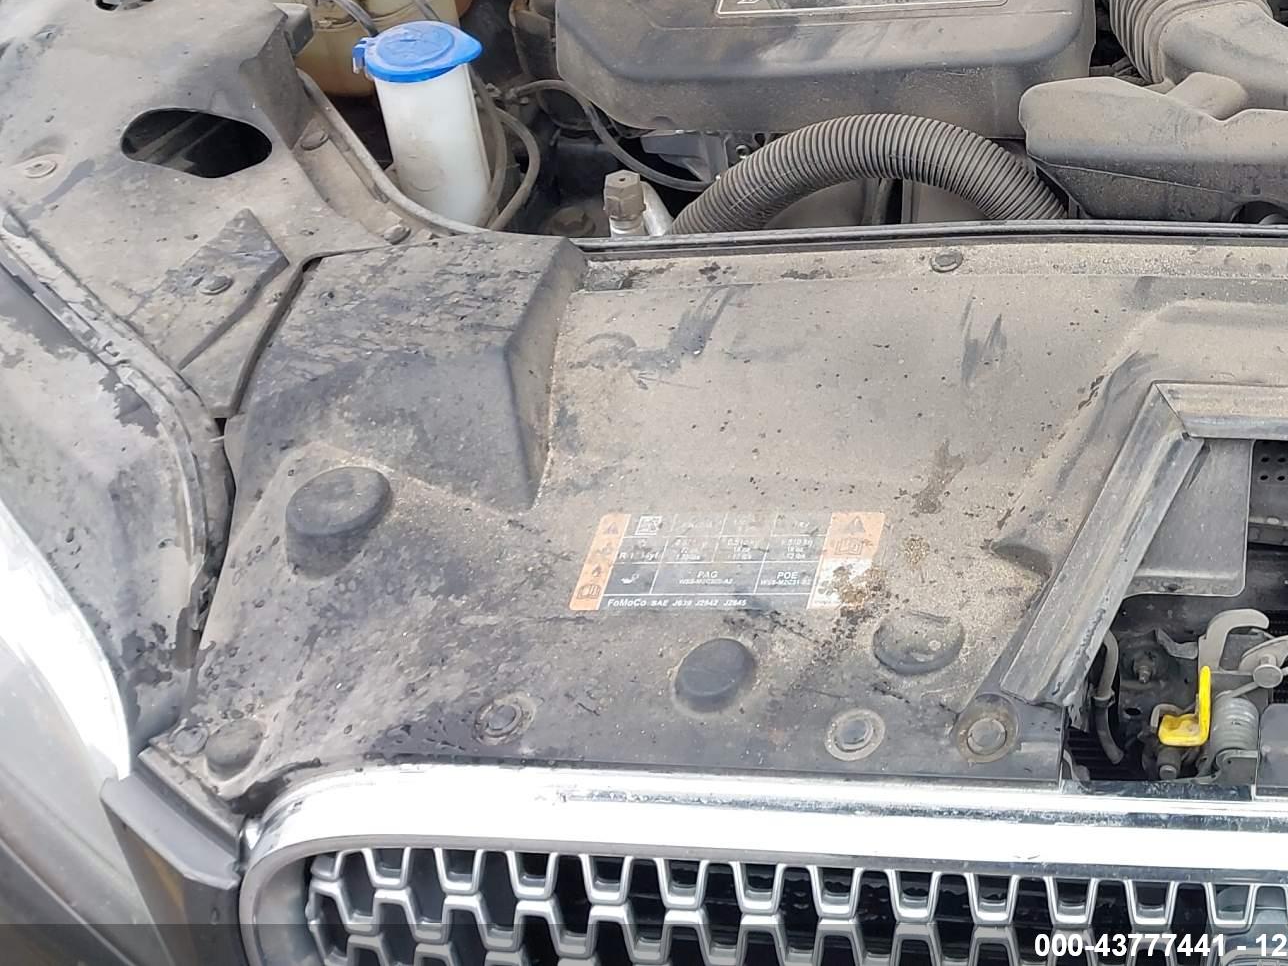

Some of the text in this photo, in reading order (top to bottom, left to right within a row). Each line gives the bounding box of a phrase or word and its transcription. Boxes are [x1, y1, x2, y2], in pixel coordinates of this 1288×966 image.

[776, 571, 799, 579] POE
[607, 598, 647, 607] FoMoCo
[650, 599, 669, 607] SAE
